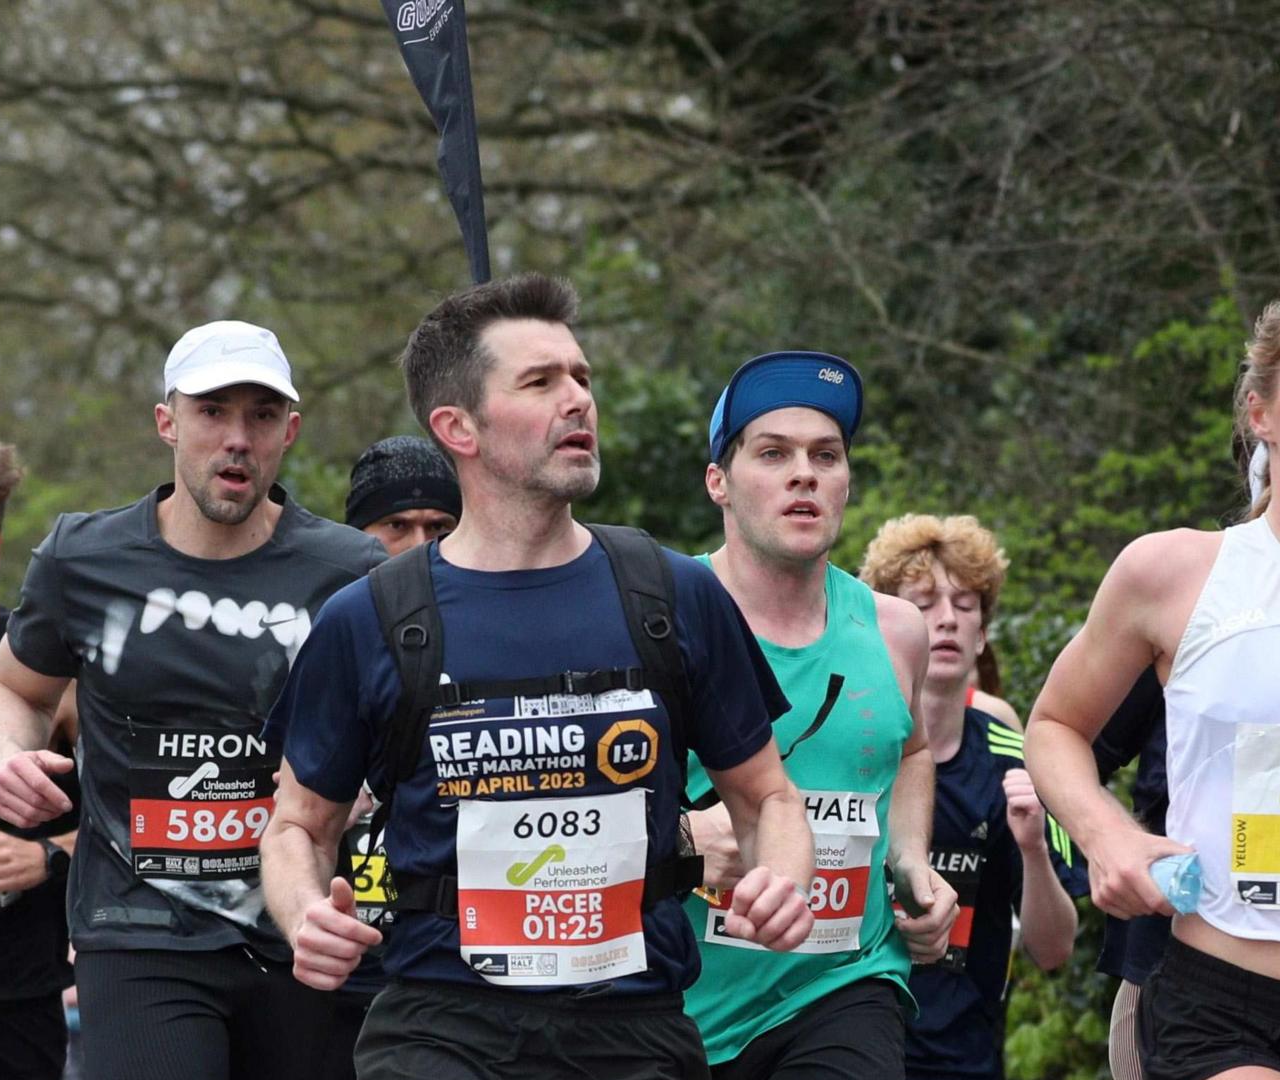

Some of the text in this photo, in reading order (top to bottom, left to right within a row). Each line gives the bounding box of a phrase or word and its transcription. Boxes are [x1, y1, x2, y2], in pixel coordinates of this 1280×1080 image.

[158, 733, 267, 758] HERON
[429, 725, 586, 762] READING
[613, 741, 648, 763] 13.1
[437, 754, 586, 779] HALF MARATHON
[191, 790, 256, 800] Performance
[203, 779, 256, 791] Unleashed
[437, 772, 586, 797] 2ND APRIL 2023
[805, 797, 866, 822] HAEL
[136, 814, 145, 834] RED
[166, 806, 269, 842] 5869
[513, 809, 601, 839] 6083
[816, 847, 846, 857] ashed
[1236, 819, 1247, 868] YELLOW
[548, 862, 607, 877] Unleashed
[928, 852, 979, 872] LLEN
[534, 877, 608, 888] Performance
[810, 876, 850, 912] 80
[526, 892, 603, 914] PACER
[466, 907, 477, 929] RED
[523, 913, 604, 940] 01:25
